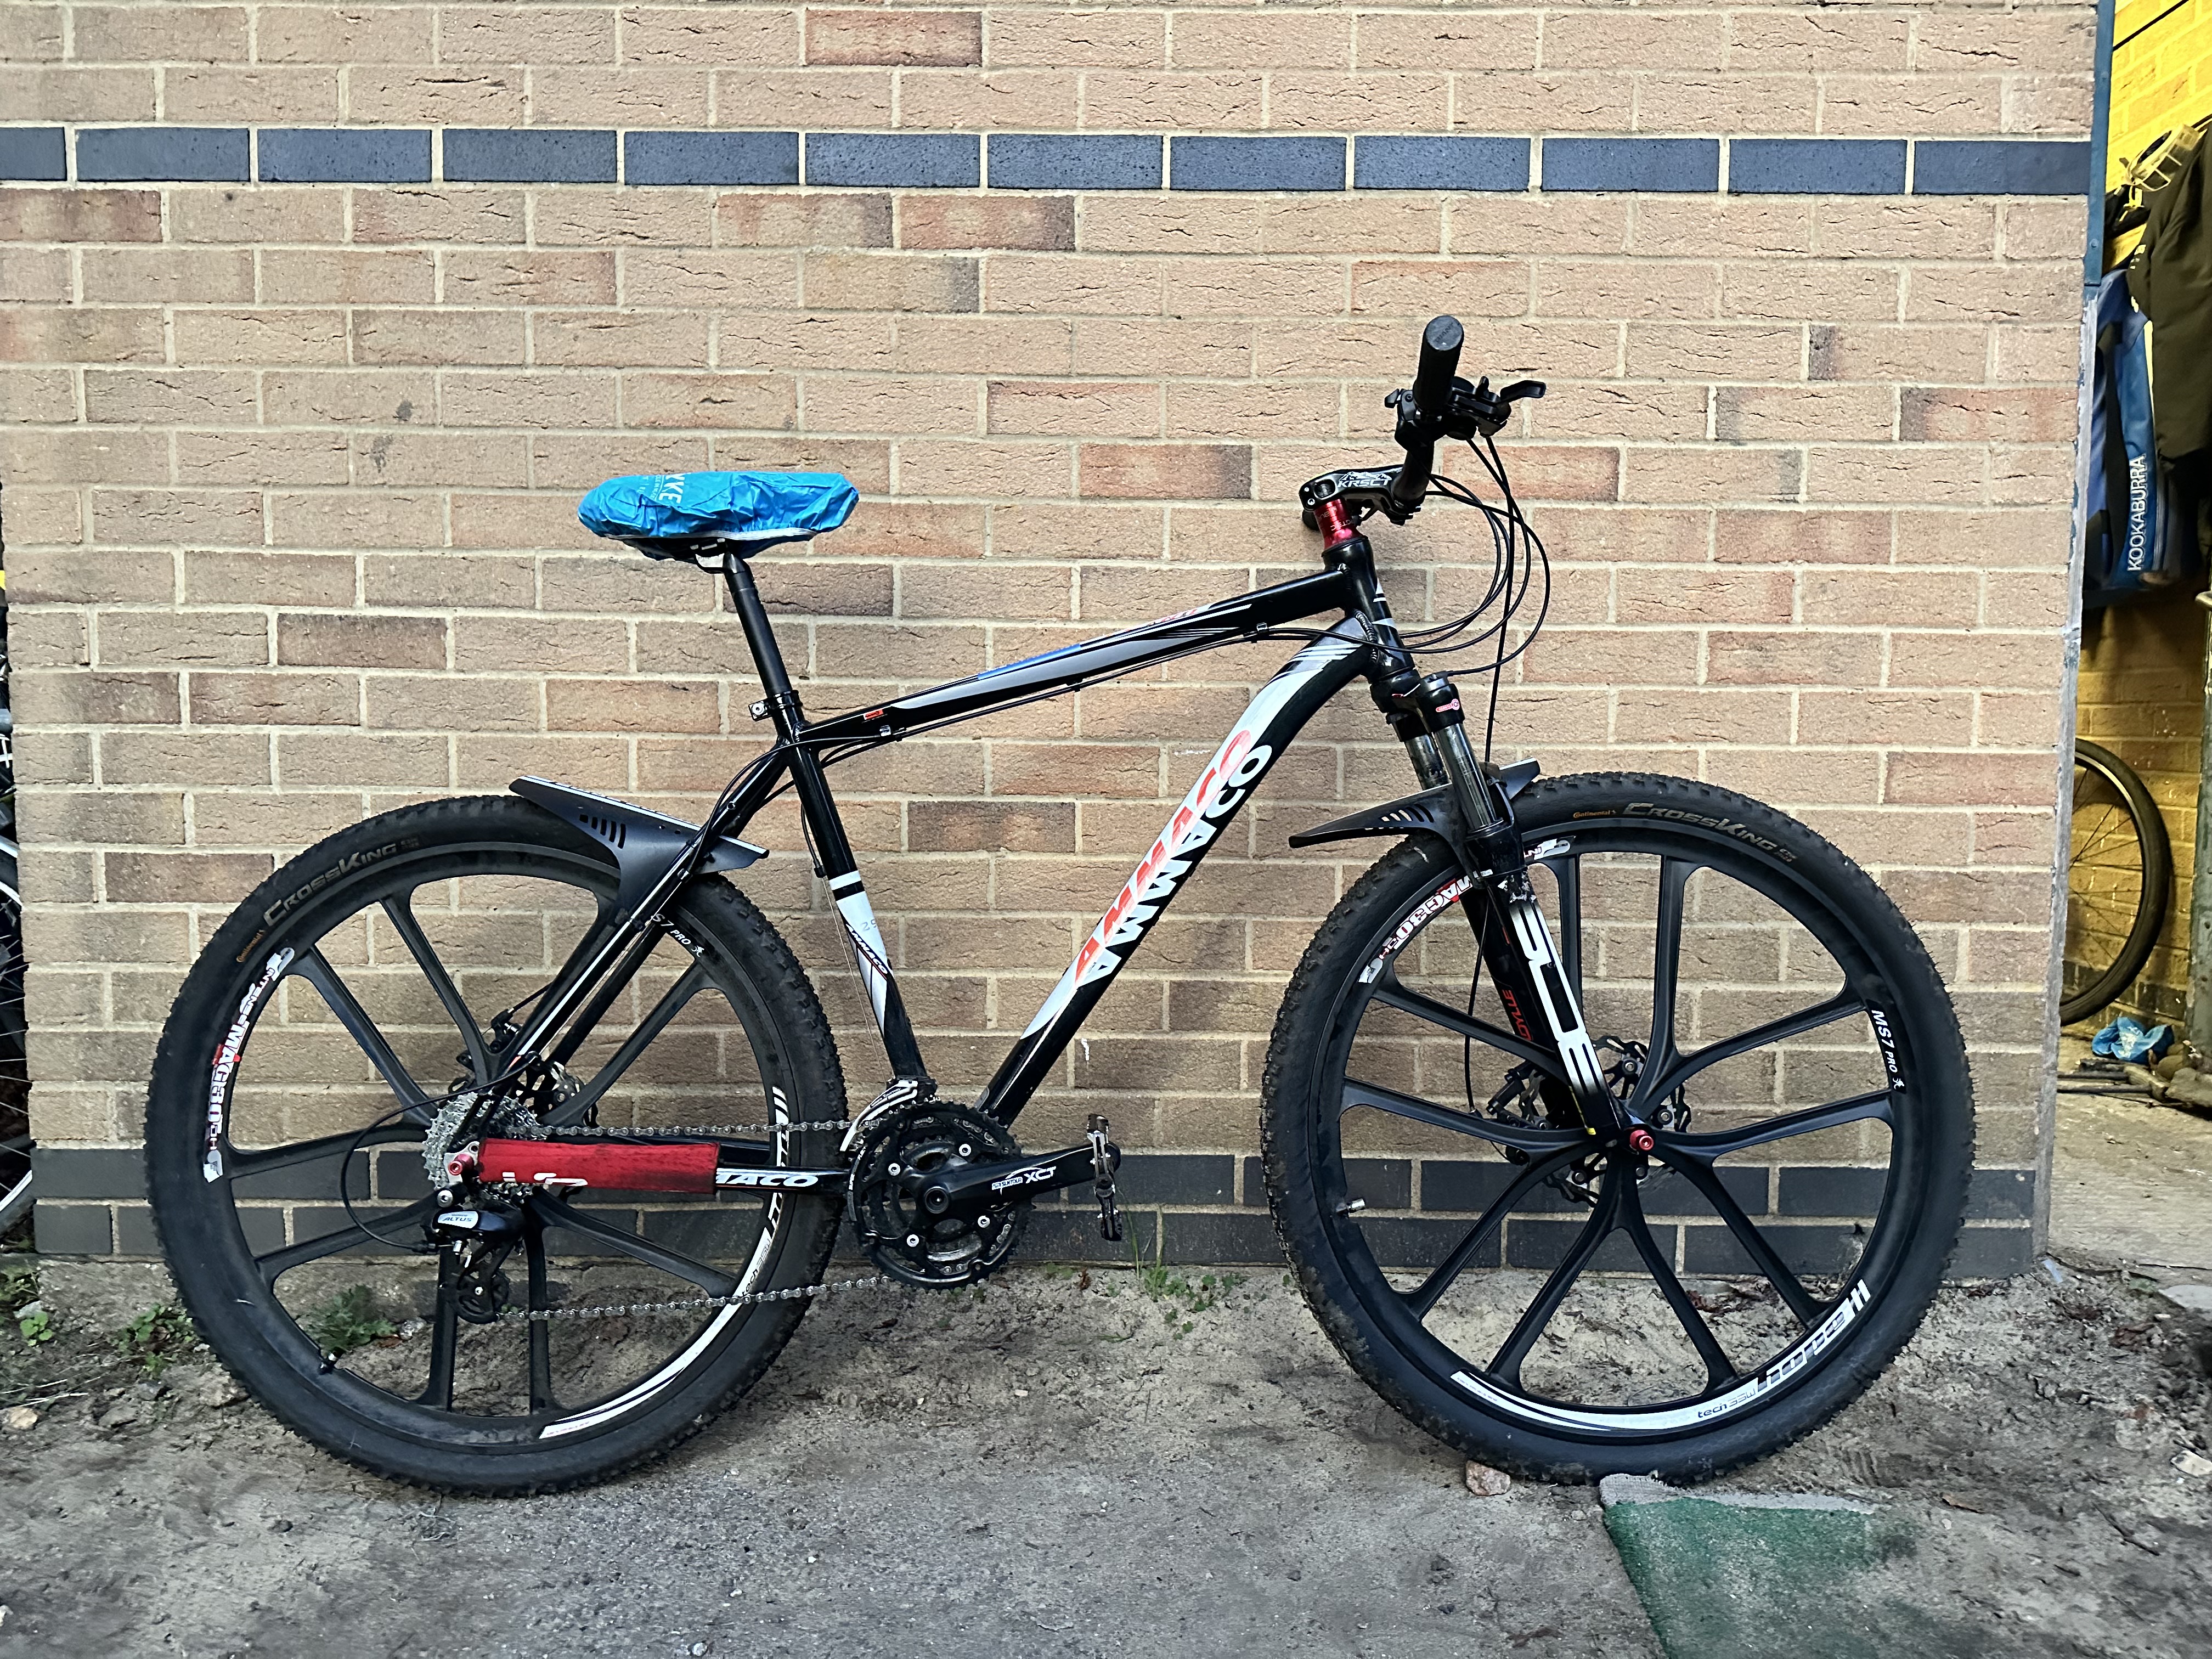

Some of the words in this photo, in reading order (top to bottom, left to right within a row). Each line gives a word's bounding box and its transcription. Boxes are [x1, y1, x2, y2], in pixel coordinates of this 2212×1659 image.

[2128, 454, 2146, 572] KOOKABURRA
[1573, 810, 1611, 819] Continental
[669, 929, 692, 946] PRO
[846, 924, 888, 974] AMMACO
[1871, 1009, 1894, 1049] MS7
[1885, 1050, 1898, 1074] PRO
[1024, 1166, 1057, 1184] XCT
[1697, 1402, 1728, 1419] tech
